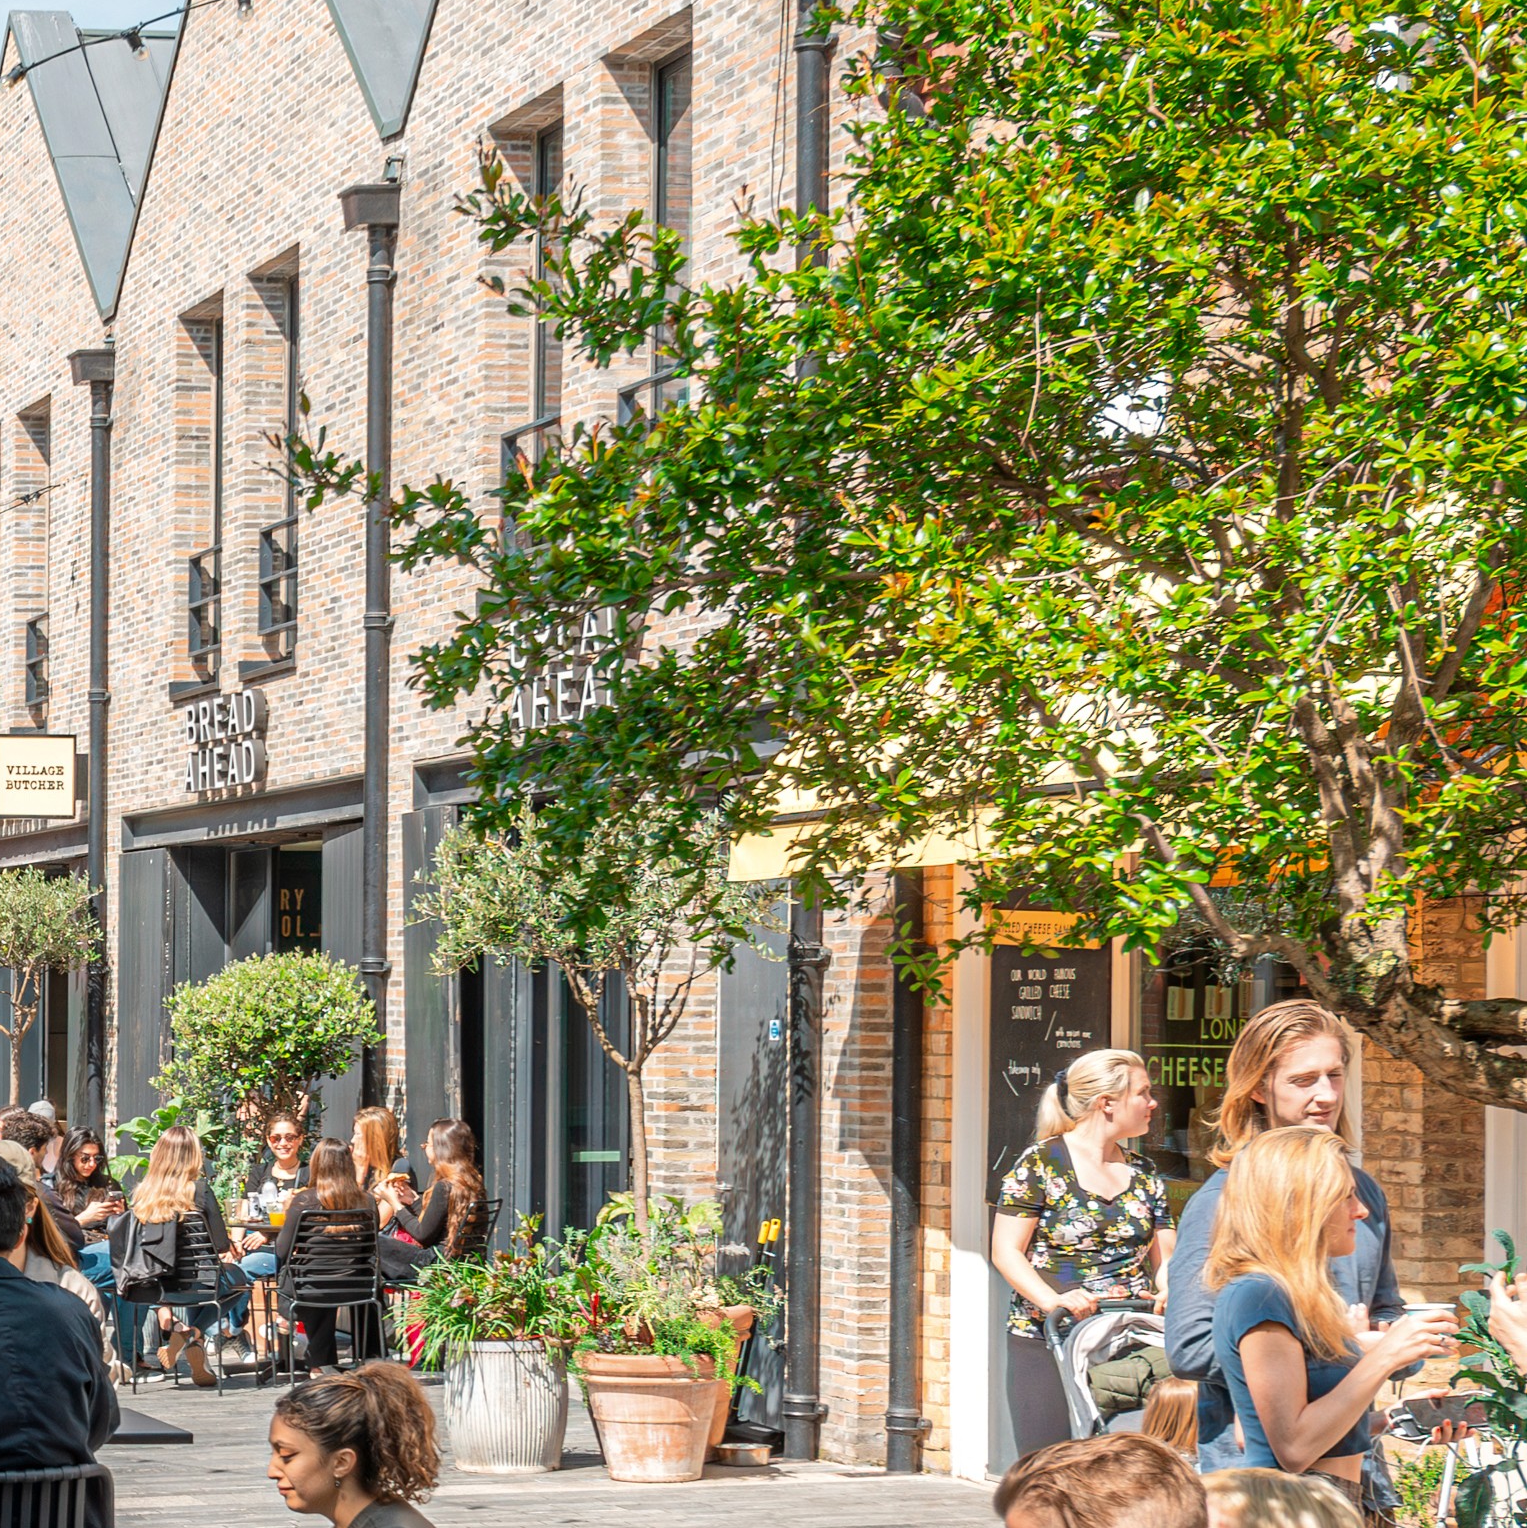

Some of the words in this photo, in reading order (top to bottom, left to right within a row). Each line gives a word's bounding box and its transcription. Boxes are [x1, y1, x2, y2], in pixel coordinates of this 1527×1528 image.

[185, 688, 258, 746] BREAD
[6, 765, 65, 776] VILLAGE
[184, 738, 258, 793] AHEAD
[5, 780, 65, 790] BUTCHER
[1023, 922, 1051, 935] CHEESE
[1049, 983, 1071, 1000] CHEESE
[1147, 1056, 1228, 1088] CHEESE
